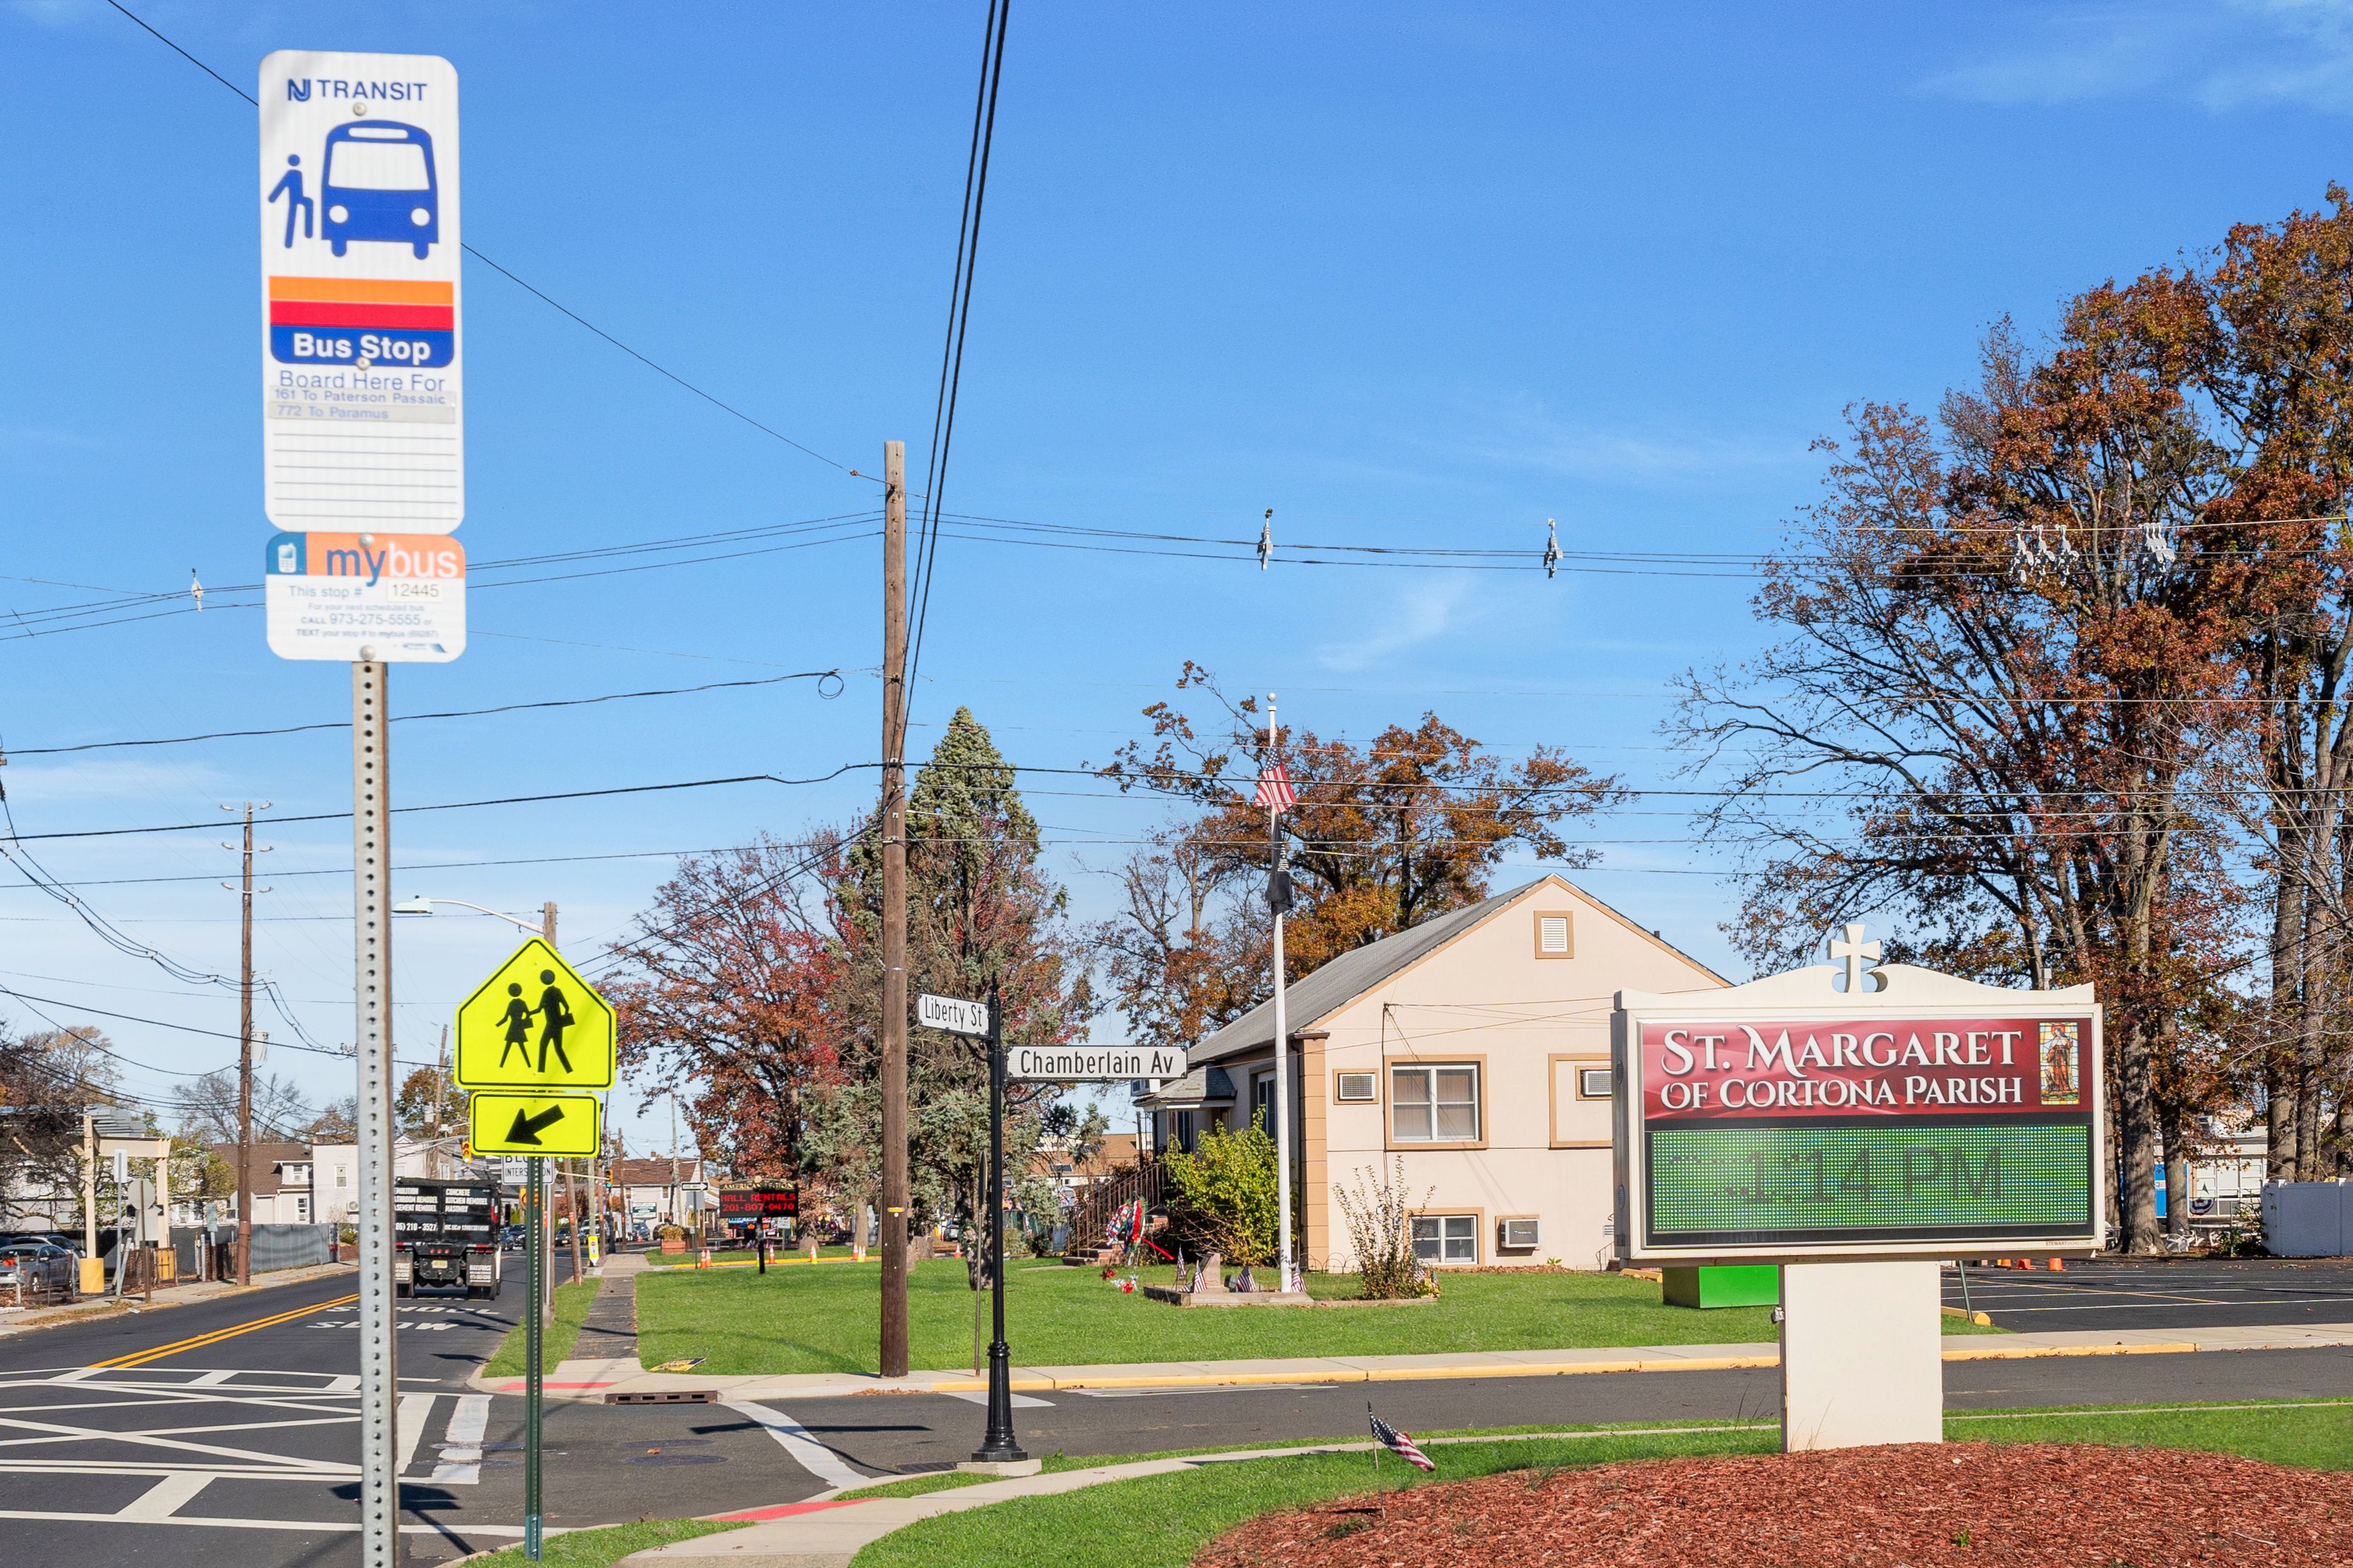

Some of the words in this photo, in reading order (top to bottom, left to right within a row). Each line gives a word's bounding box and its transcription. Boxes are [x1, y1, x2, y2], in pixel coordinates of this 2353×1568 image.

[317, 79, 427, 101] TRANSIT
[292, 332, 353, 358] Bus
[360, 335, 431, 365] Stop
[280, 370, 345, 389] Board
[354, 373, 403, 390] Here
[411, 374, 445, 392] For
[275, 389, 296, 399] 161
[303, 390, 318, 401] To
[325, 391, 386, 403] Paterson
[393, 392, 446, 404] Passaic
[277, 404, 302, 416] 772
[309, 406, 325, 417] To
[330, 407, 388, 419] Paramus
[326, 541, 458, 587] mybus
[288, 585, 316, 597] This
[321, 586, 350, 599] stop
[354, 587, 362, 596] #
[392, 583, 440, 597] 12445
[308, 602, 321, 610] For
[365, 603, 407, 611] scheduled
[301, 616, 326, 624] CALL
[330, 614, 421, 626] 973-275-5555
[342, 630, 359, 638] stop
[925, 996, 965, 1030] Liberty
[971, 1004, 982, 1027] St
[1660, 1029, 1731, 1076] ST.
[1737, 1024, 2022, 1078] MARGARET
[1020, 1050, 1141, 1074] Chamberlain
[1151, 1051, 1173, 1074] Av
[1660, 1081, 1709, 1109] OF
[1719, 1078, 1899, 1108] CORTONA
[1904, 1075, 2023, 1106] PARISH
[505, 1167, 551, 1177] INTERSON
[1903, 1145, 2003, 1202] PM
[446, 1188, 471, 1196] CONCRETE
[720, 1193, 747, 1202] HALL
[751, 1193, 796, 1201] RENTALS
[722, 1202, 795, 1212] 201-807-0470
[326, 1306, 499, 1315] SHOOL
